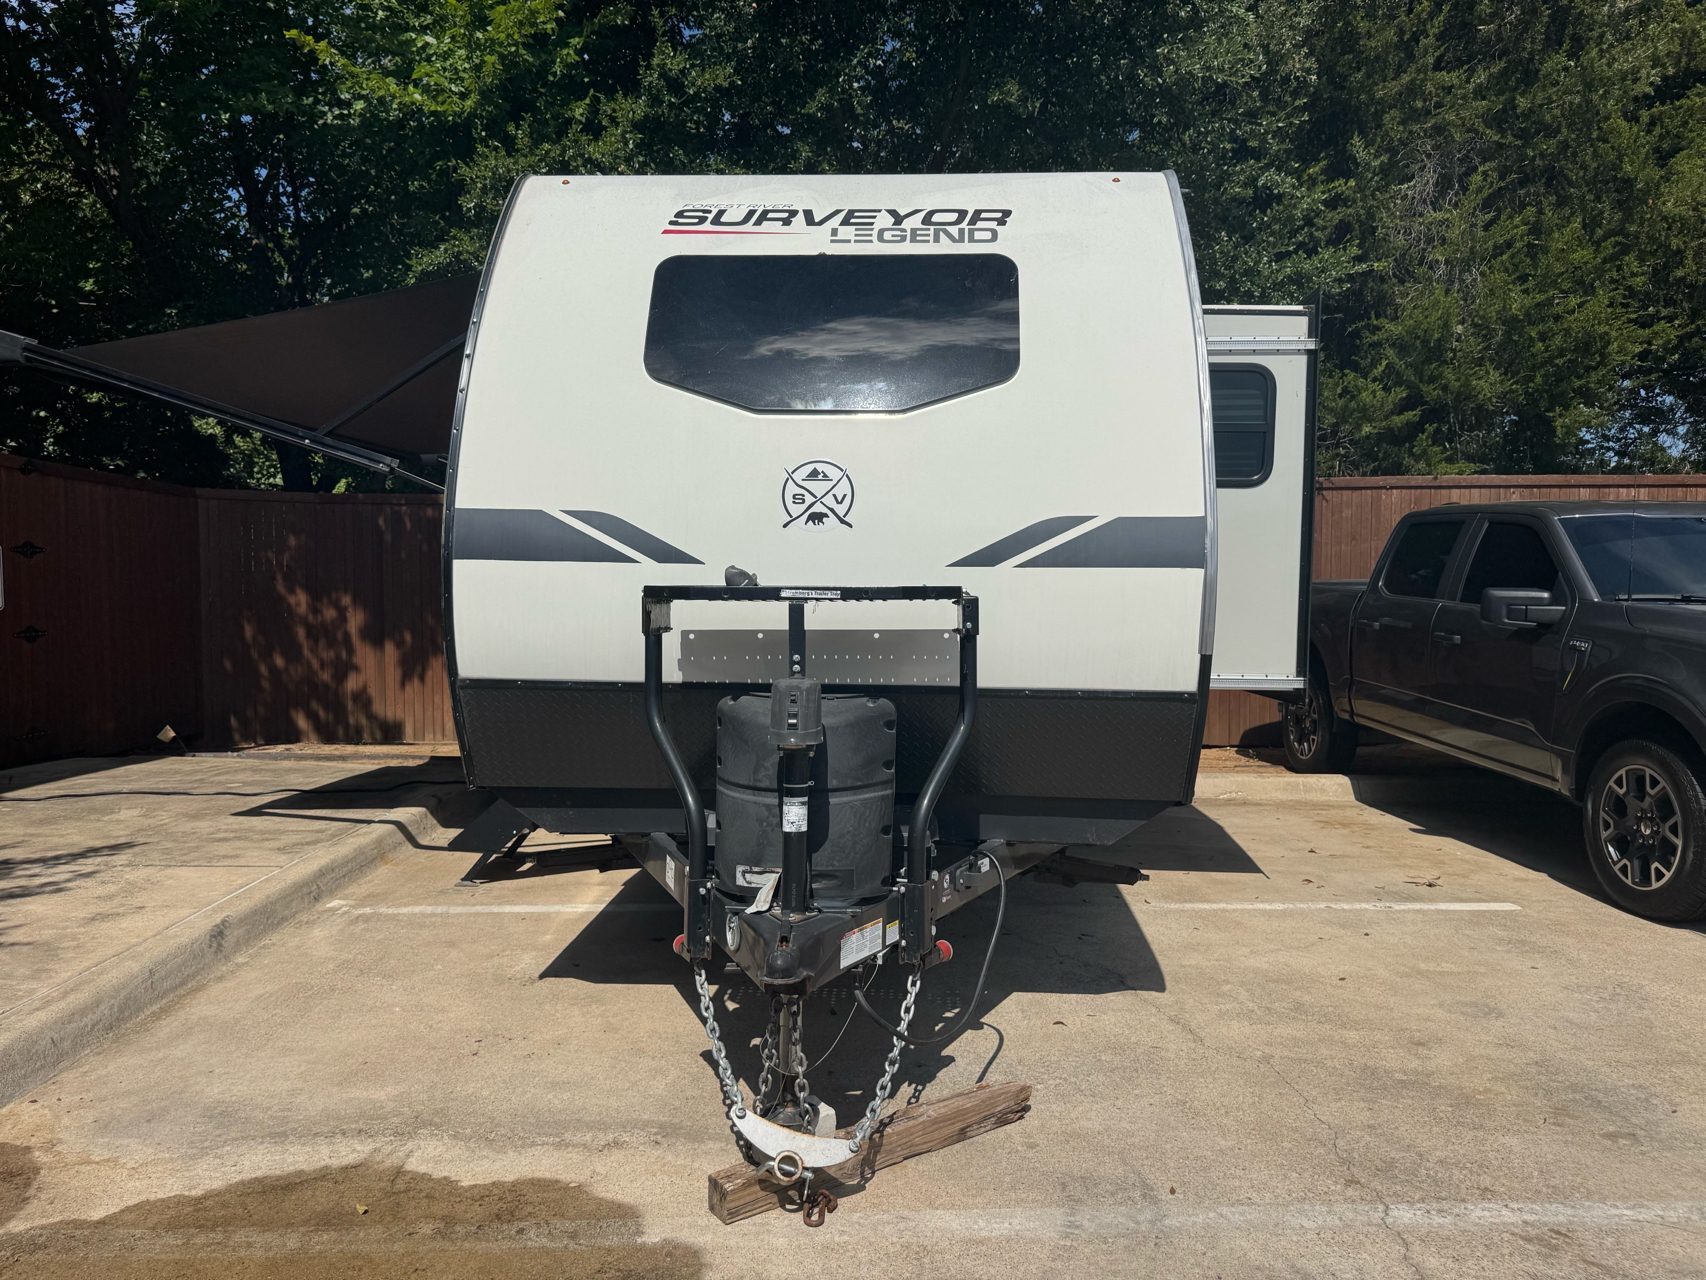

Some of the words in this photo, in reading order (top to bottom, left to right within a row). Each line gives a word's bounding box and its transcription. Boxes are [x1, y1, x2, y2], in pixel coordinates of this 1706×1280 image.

[668, 208, 1012, 227] SURVEYOR
[830, 227, 999, 244] LEGEND
[792, 493, 806, 504] S
[832, 493, 847, 504] V
